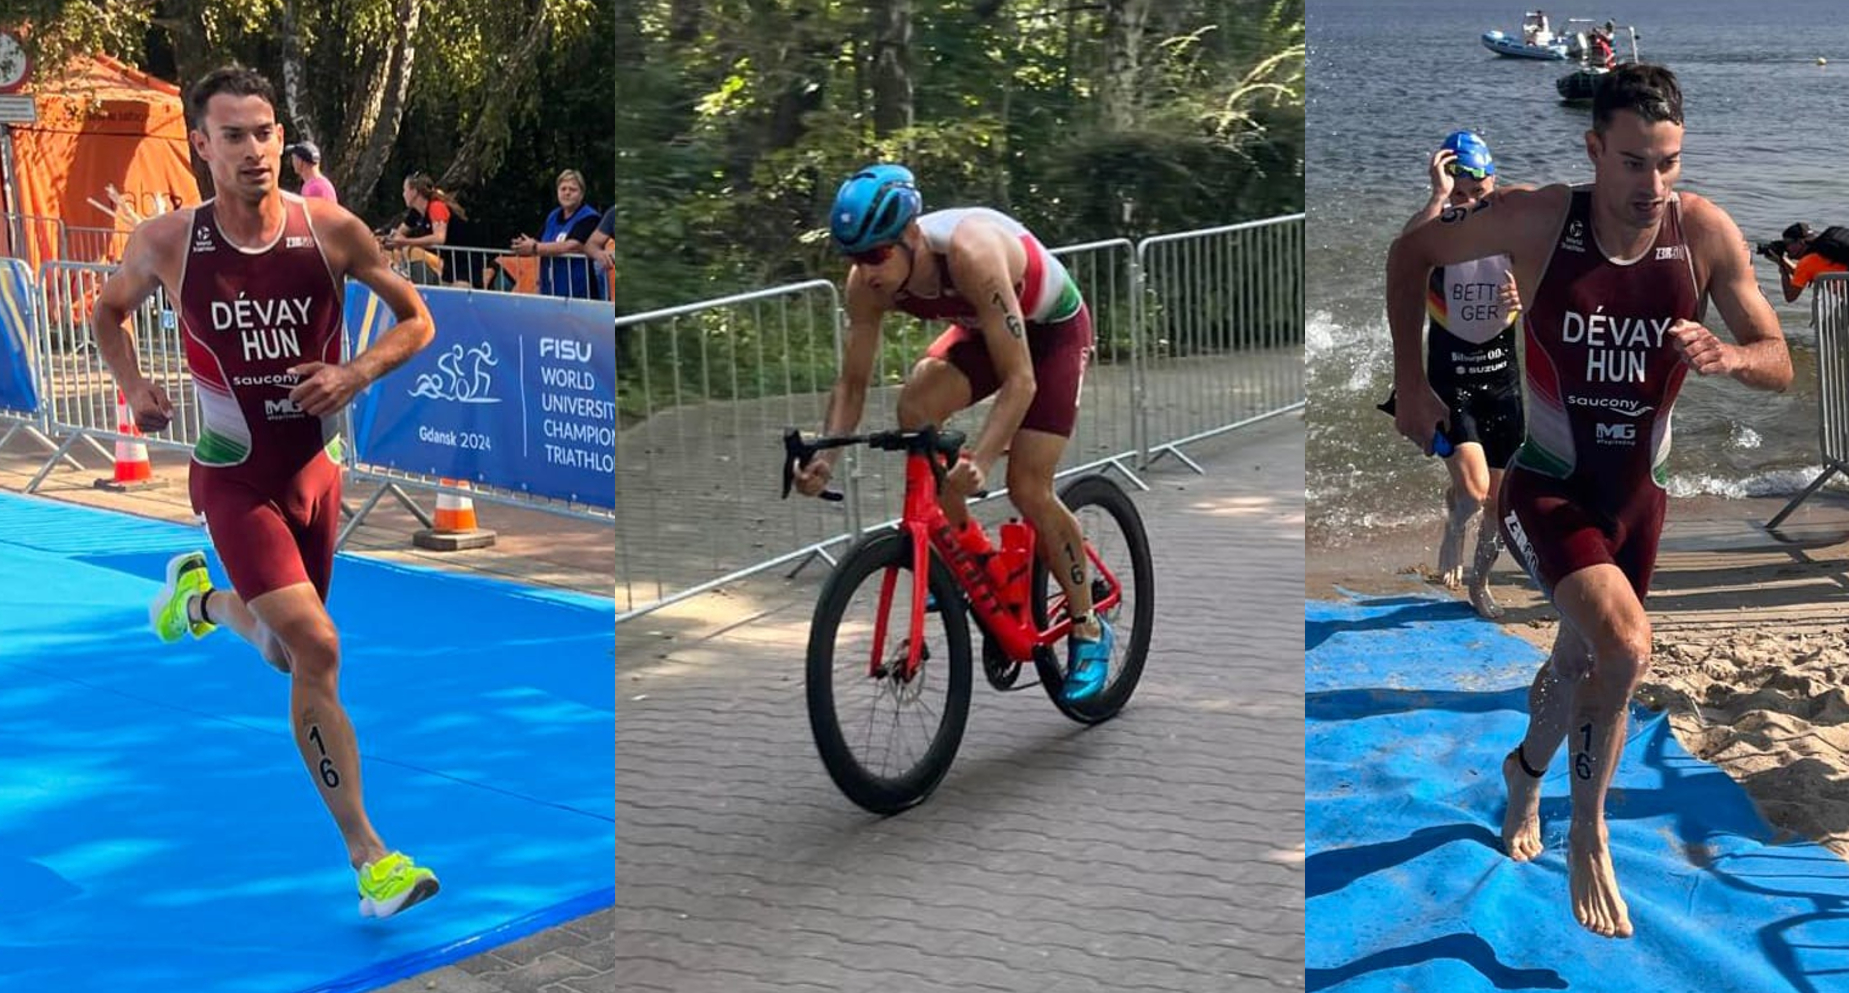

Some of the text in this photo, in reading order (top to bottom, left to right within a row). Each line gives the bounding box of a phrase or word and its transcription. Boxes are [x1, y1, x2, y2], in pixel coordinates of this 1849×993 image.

[211, 291, 312, 331] DÉVAY
[1460, 305, 1499, 322] GER
[1562, 305, 1671, 348] DÉVAY
[242, 327, 302, 362] HUN
[539, 337, 592, 363] FISU
[540, 366, 595, 391] WORLD
[1586, 348, 1646, 383] HUN
[1568, 395, 1640, 409] saucony
[419, 425, 491, 451] Gdansk 2024
[545, 444, 615, 474] TRIATHLO
[1061, 541, 1085, 587] 16
[309, 725, 340, 789] 16
[1574, 722, 1593, 781] 16
